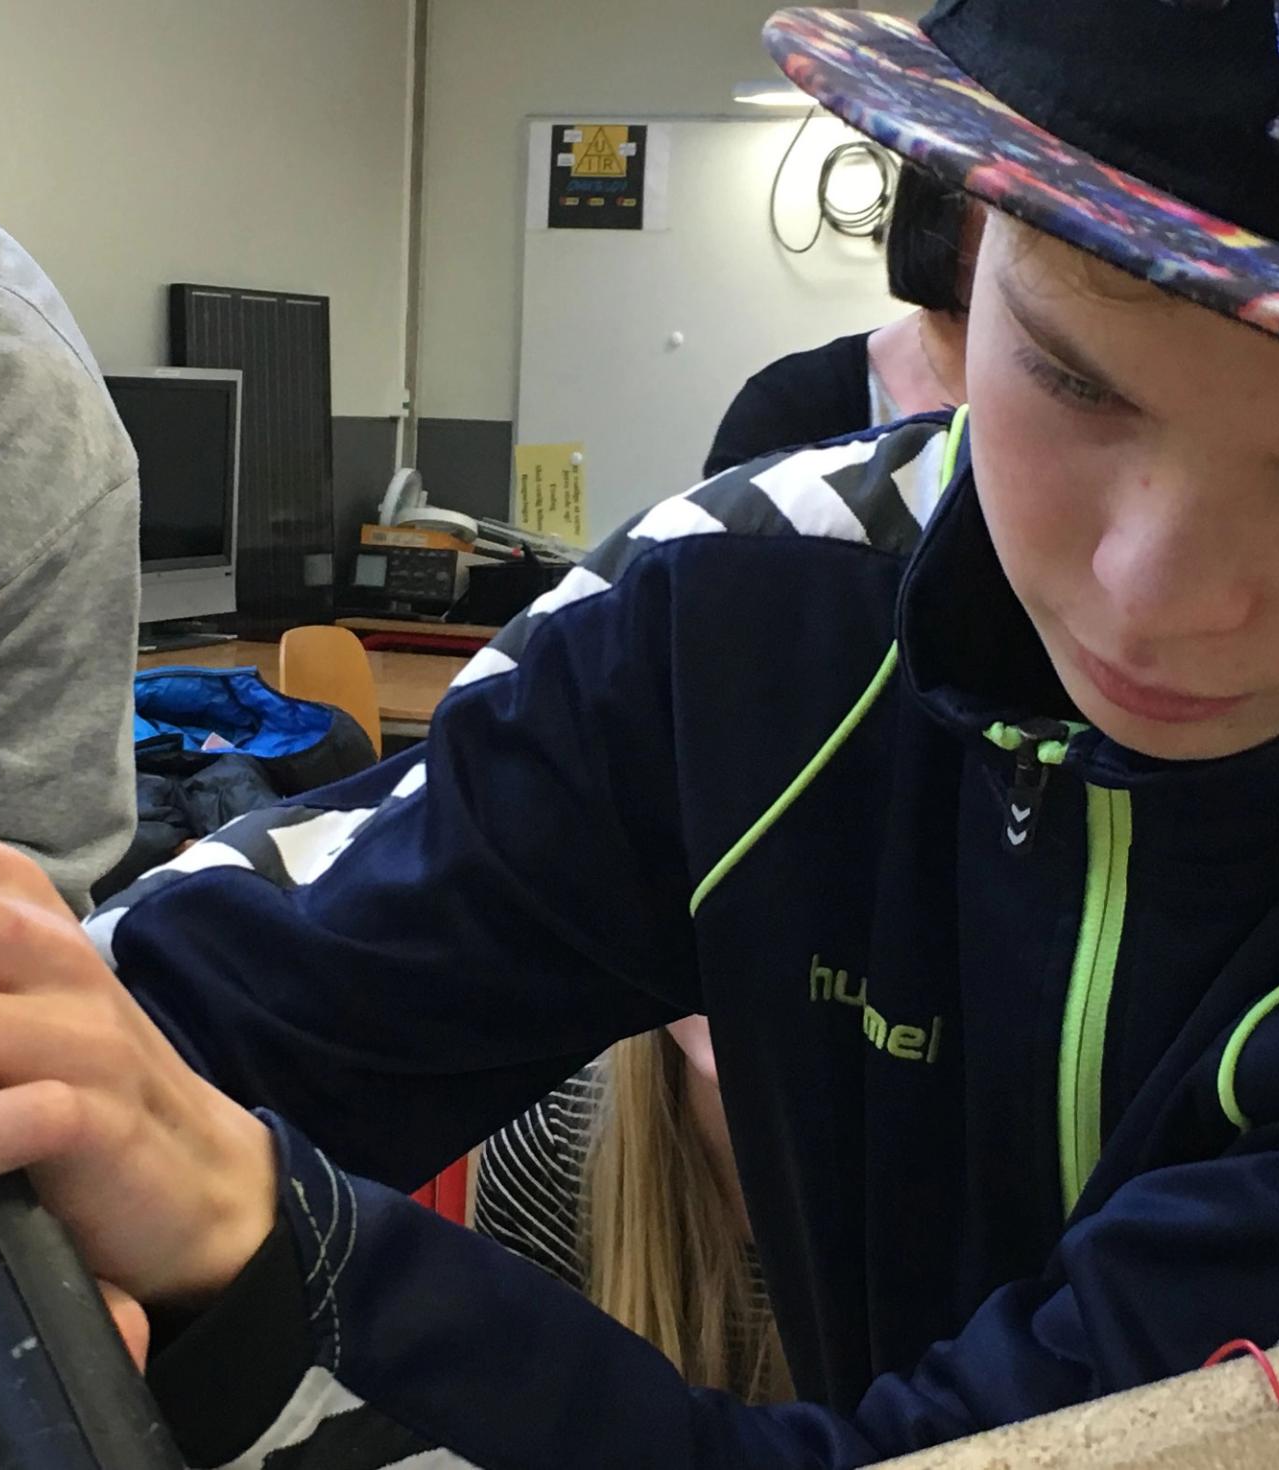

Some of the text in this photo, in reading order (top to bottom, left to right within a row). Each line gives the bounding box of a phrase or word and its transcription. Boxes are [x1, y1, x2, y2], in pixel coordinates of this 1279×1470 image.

[595, 140, 606, 153] U
[603, 157, 613, 171] R
[809, 953, 943, 1063] humel
